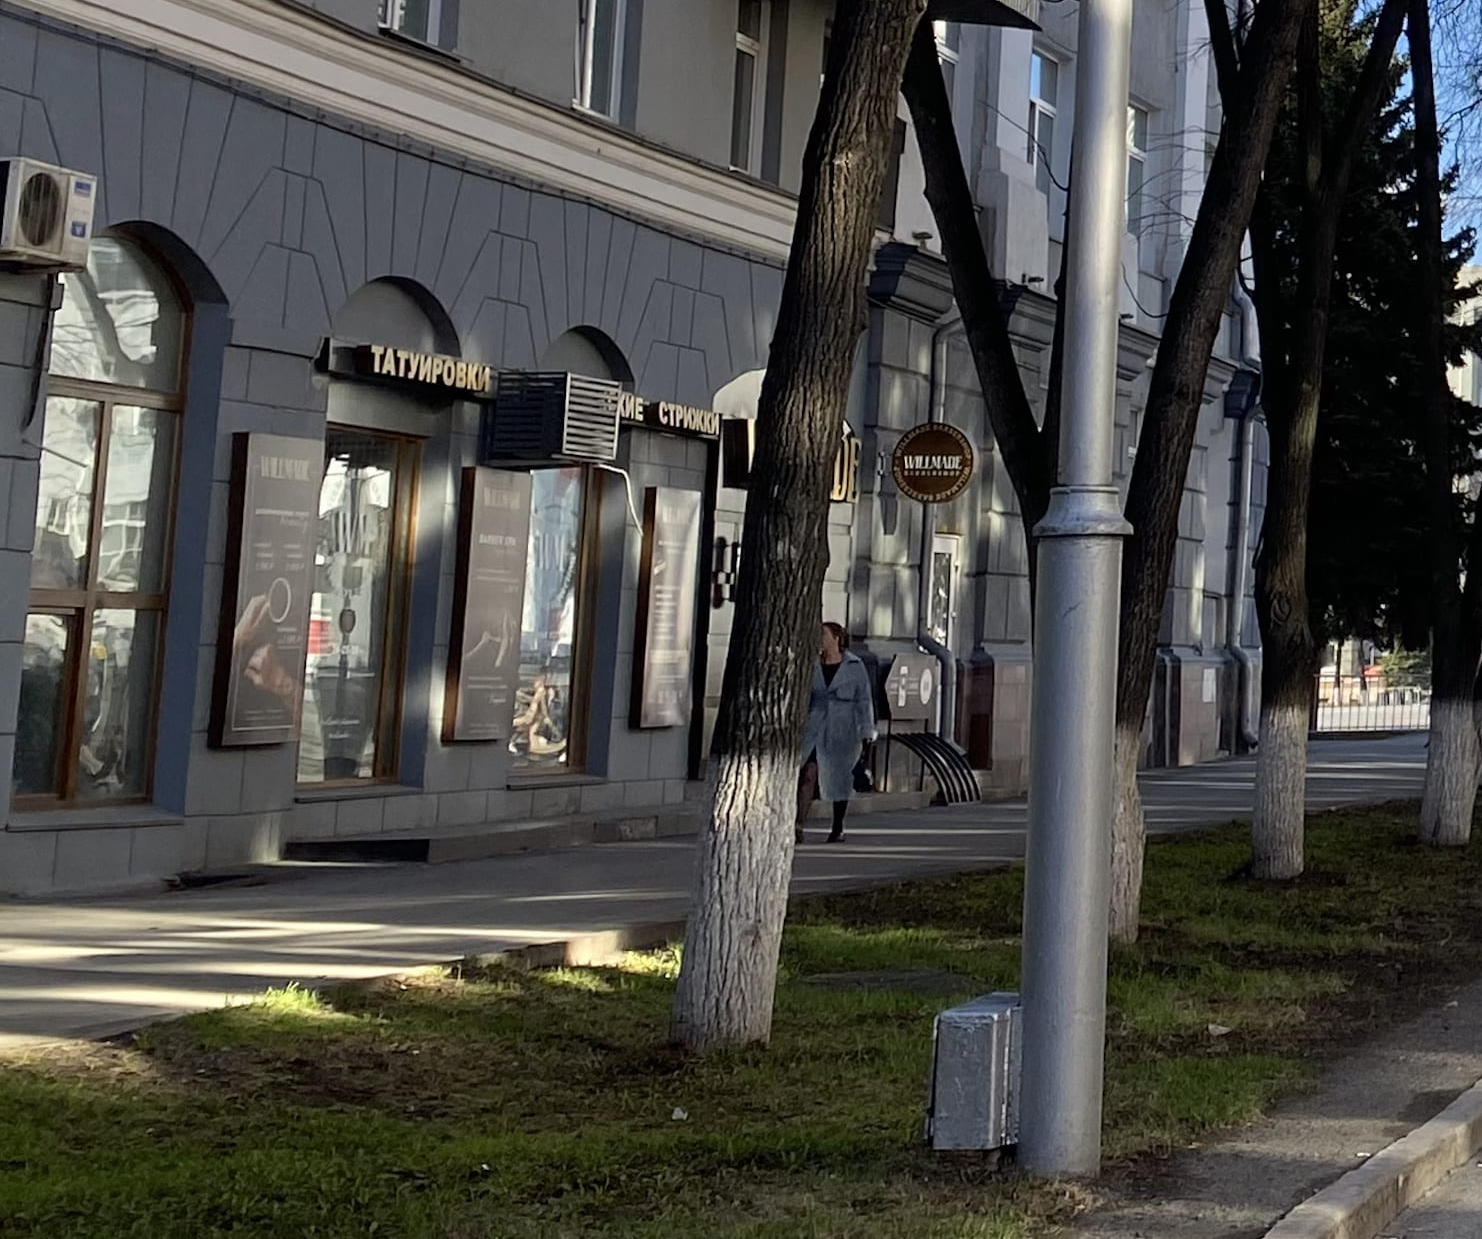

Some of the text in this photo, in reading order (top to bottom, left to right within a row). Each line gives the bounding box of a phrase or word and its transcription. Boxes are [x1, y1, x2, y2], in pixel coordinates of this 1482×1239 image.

[371, 345, 491, 392] ТАТУИРОВКИ
[658, 400, 720, 435] СТРИЖКИ
[904, 455, 962, 469] WILLMADE
